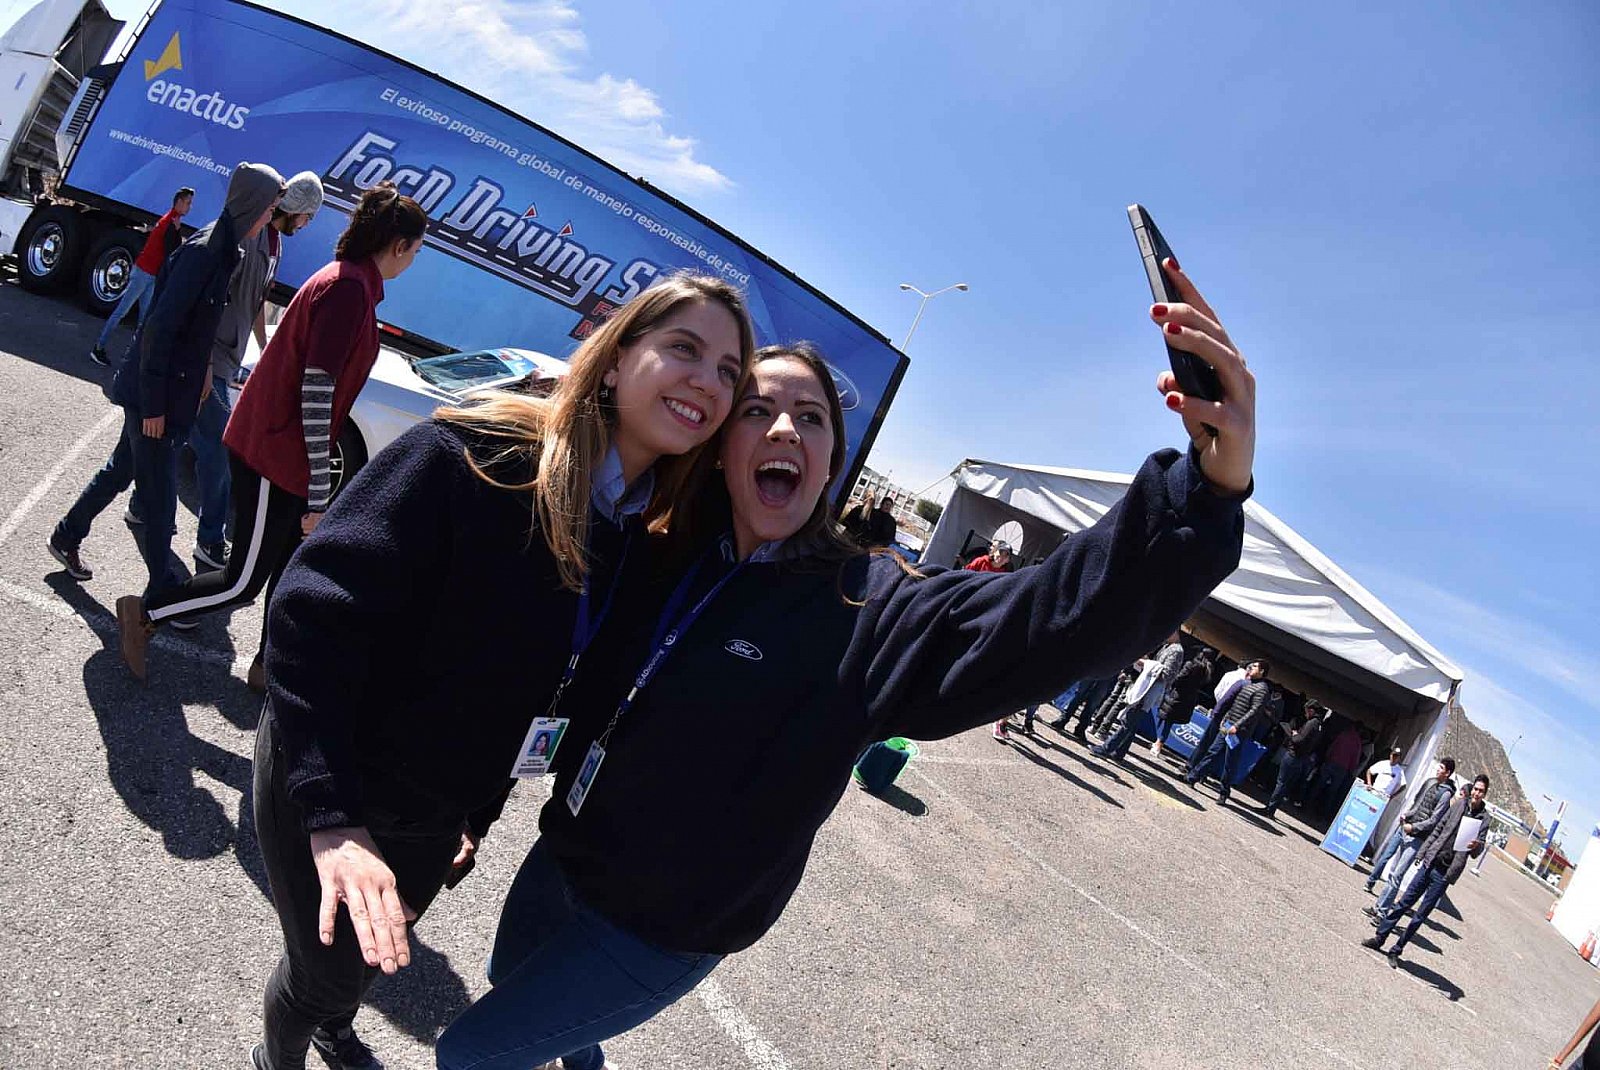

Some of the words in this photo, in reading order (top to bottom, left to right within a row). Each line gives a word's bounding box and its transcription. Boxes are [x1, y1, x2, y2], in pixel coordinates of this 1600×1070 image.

[147, 79, 250, 130] enactus
[109, 129, 232, 177] www.drivingskillsforlife.mx
[380, 88, 399, 103] El
[397, 96, 450, 125] exitoso
[447, 120, 519, 158] programa
[517, 153, 566, 180] global
[563, 175, 583, 190] de
[582, 185, 633, 217] manejo
[633, 213, 707, 259] responsable
[707, 254, 723, 270] de
[721, 262, 751, 284] Ford
[1174, 723, 1201, 746] For
